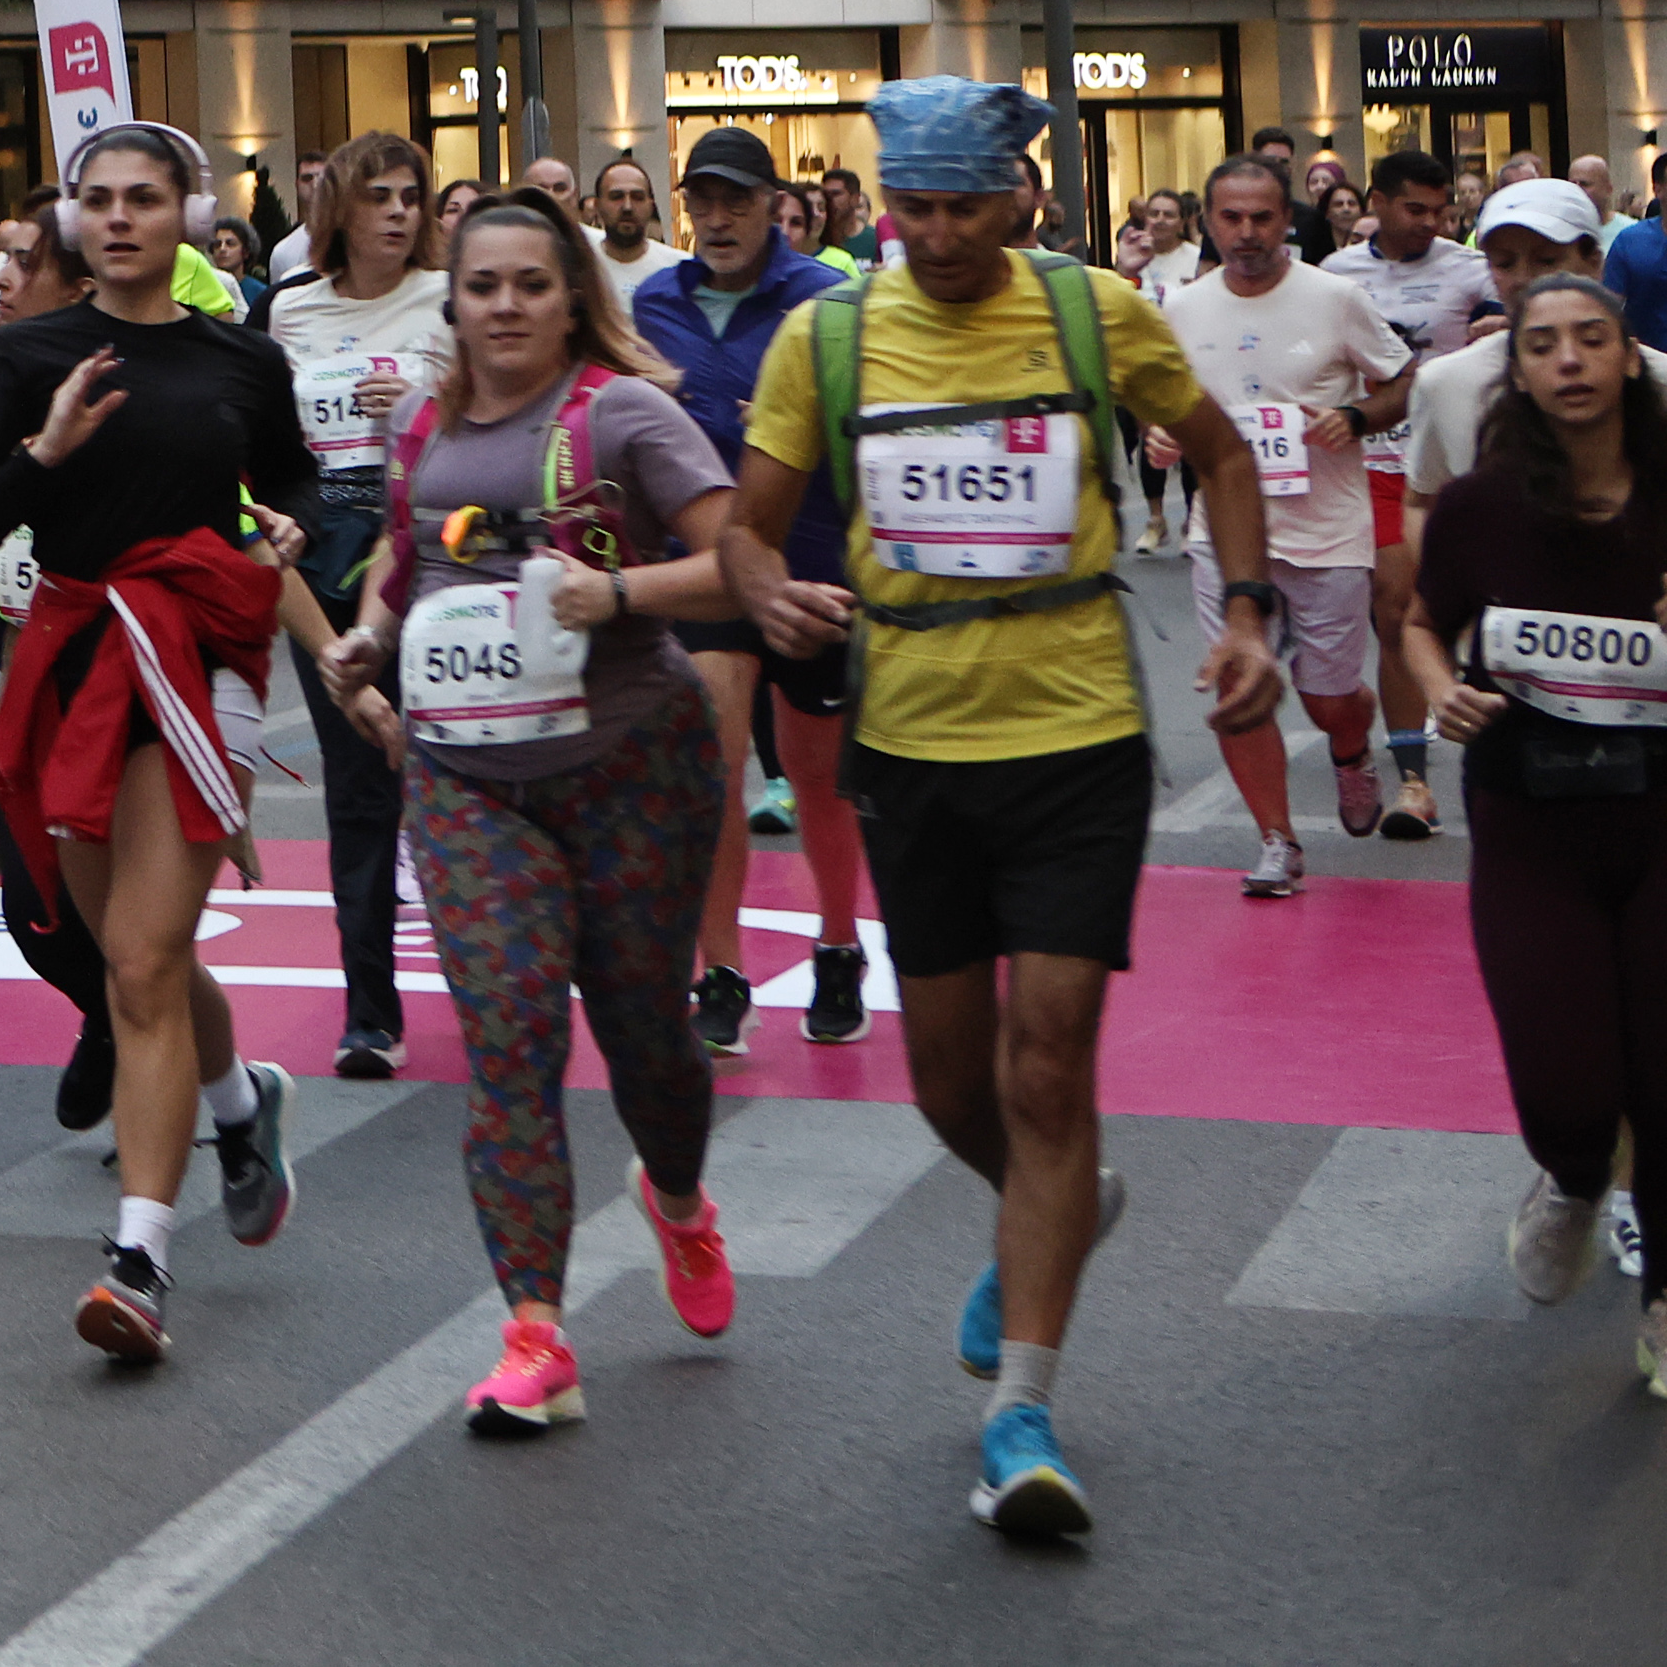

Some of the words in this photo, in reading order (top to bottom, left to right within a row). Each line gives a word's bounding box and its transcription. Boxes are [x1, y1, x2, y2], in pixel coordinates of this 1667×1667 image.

[1387, 33, 1472, 69] POLO
[717, 55, 801, 92] TOD'S
[1072, 52, 1147, 90] TOD'S
[314, 396, 365, 424] 514
[900, 464, 1037, 502] 51651
[1514, 620, 1652, 667] 50800
[425, 643, 522, 683] 5048
